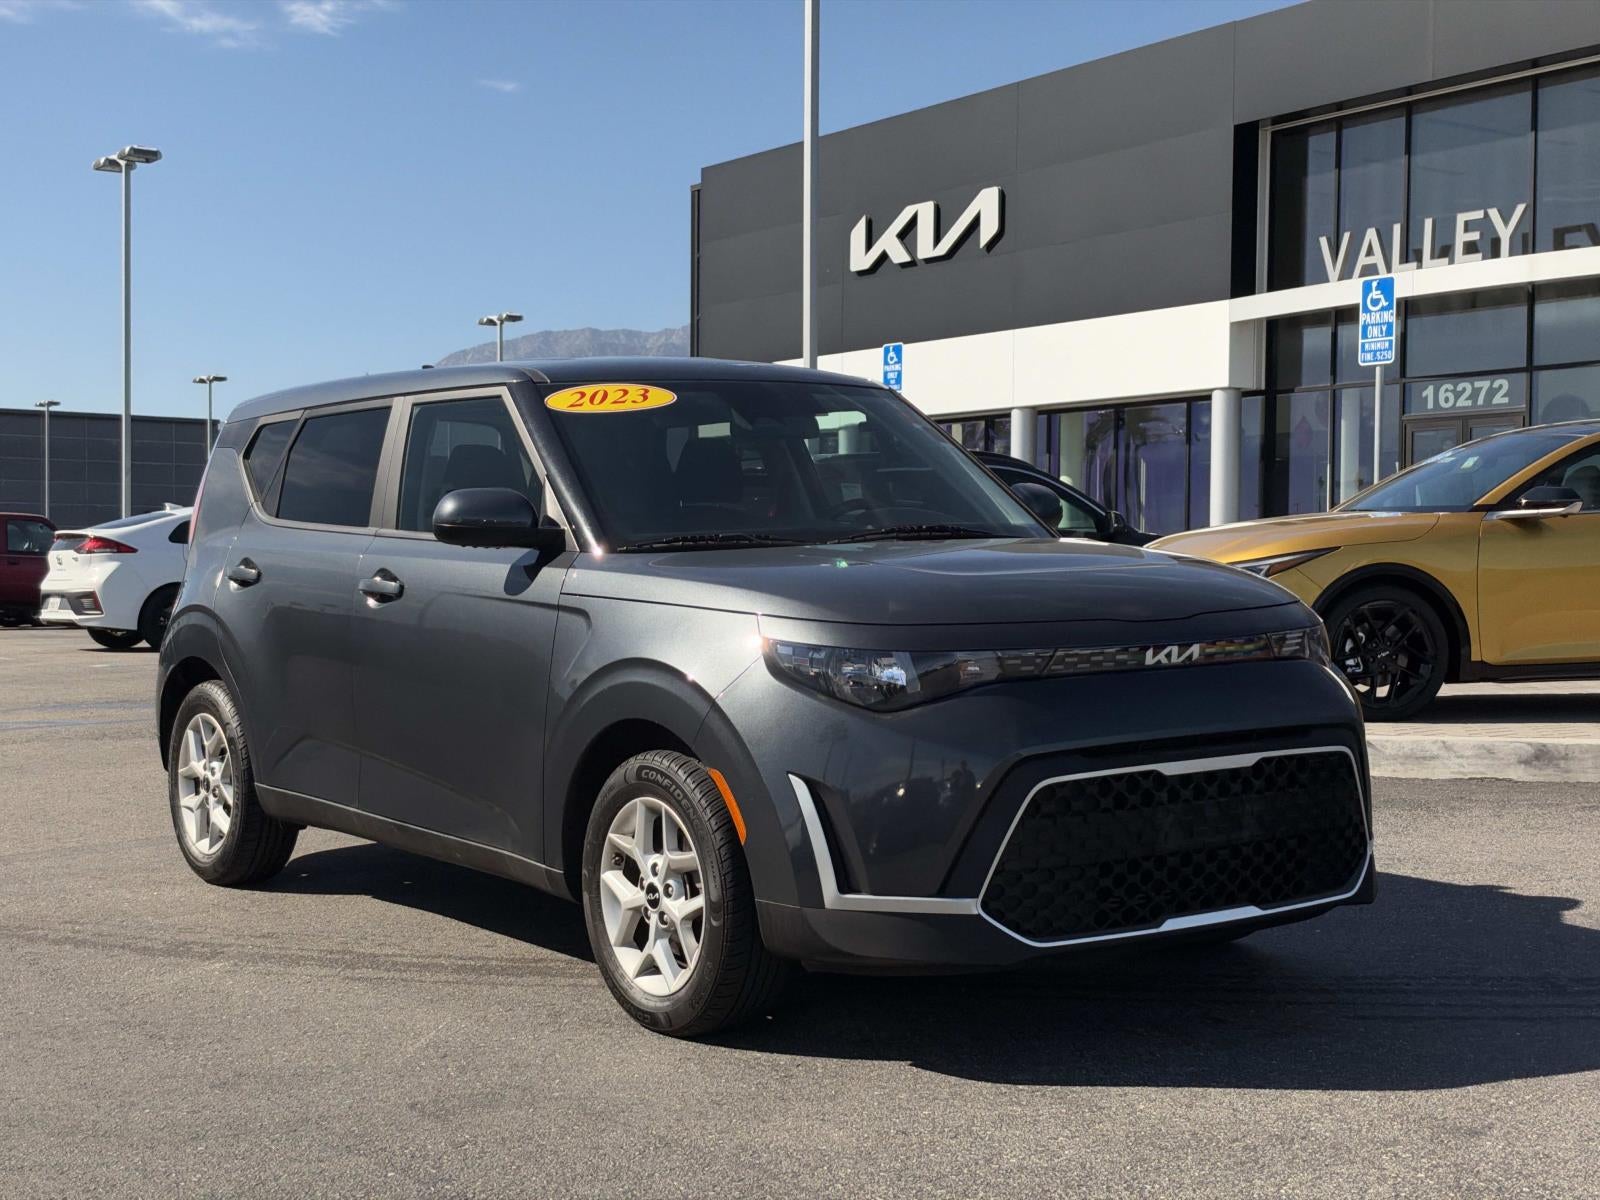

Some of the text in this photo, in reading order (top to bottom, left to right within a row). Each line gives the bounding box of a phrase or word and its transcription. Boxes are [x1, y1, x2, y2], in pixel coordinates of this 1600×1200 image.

[850, 186, 1001, 272] KIA
[1318, 203, 1527, 282] VALLEY
[1361, 310, 1393, 325] PARKING
[1367, 324, 1387, 338] ONLY
[1364, 341, 1389, 351] MINIMUM
[567, 388, 650, 408] 2023
[1422, 379, 1509, 409] 16272
[1145, 643, 1200, 665] KIA
